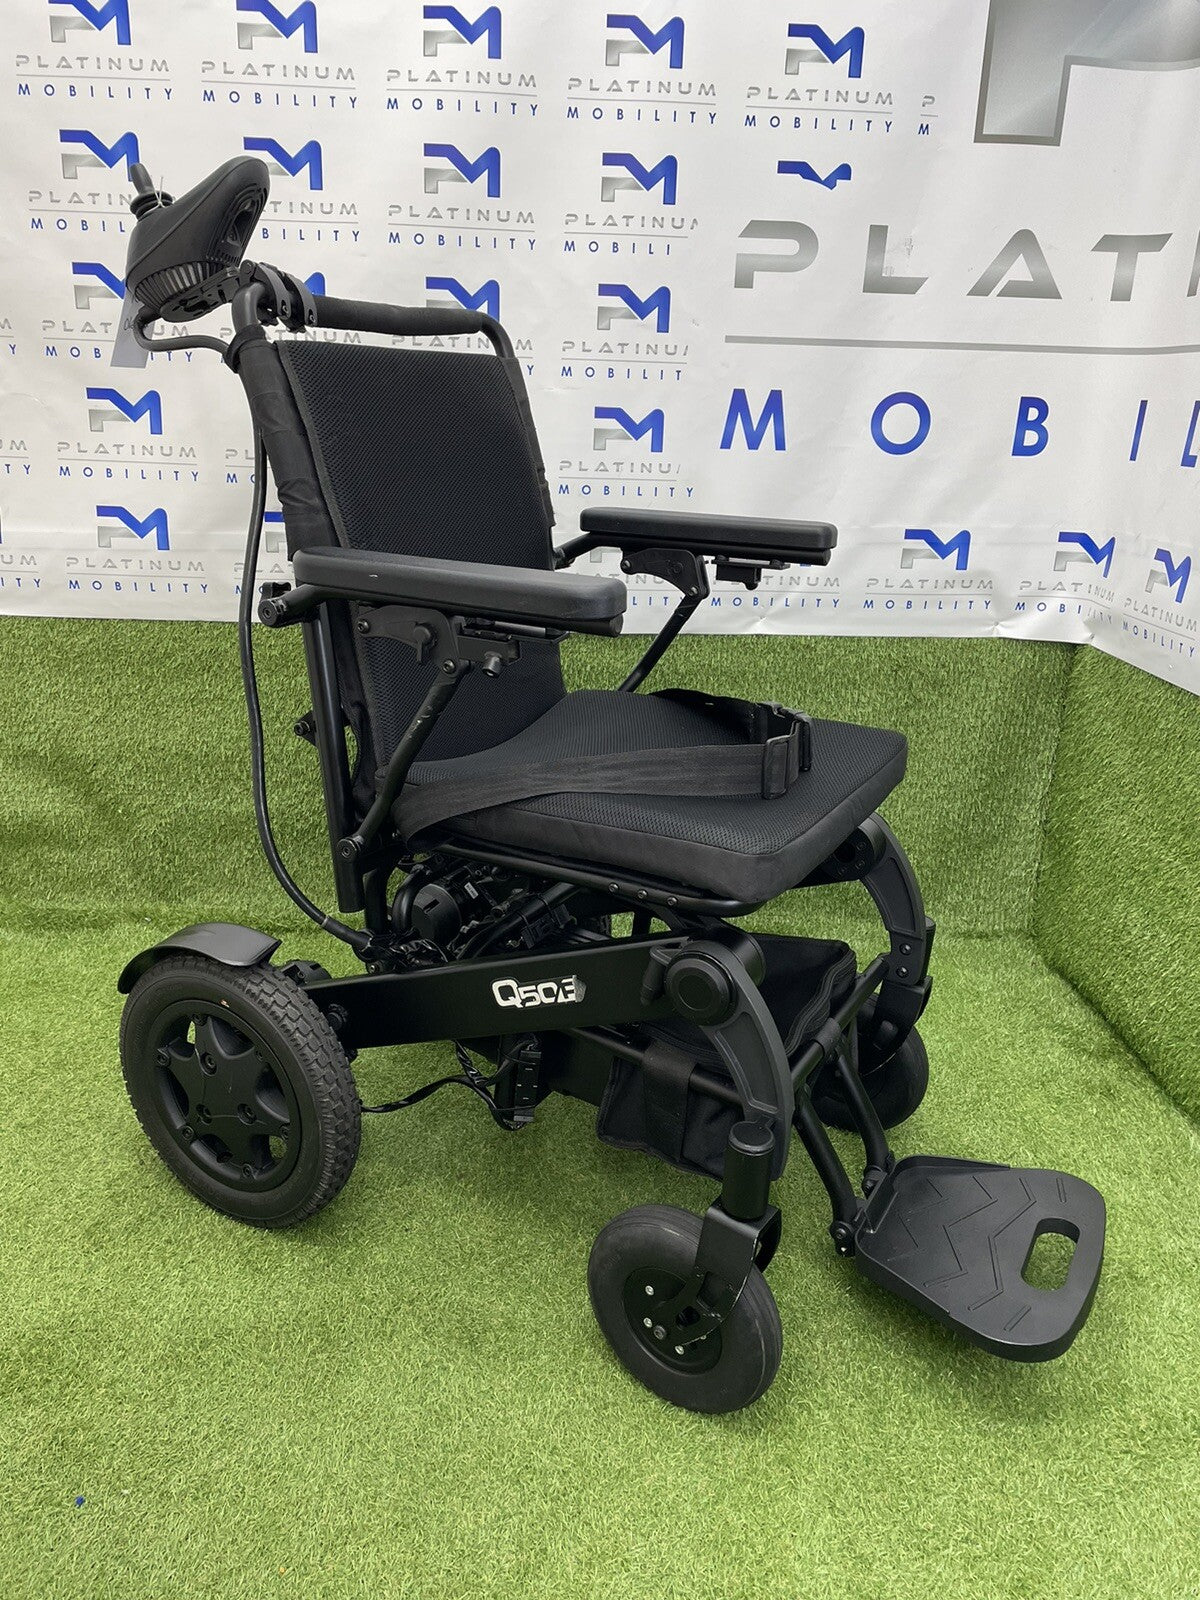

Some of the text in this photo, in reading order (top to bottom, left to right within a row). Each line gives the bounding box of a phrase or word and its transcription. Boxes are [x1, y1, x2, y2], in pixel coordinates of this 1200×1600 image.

[16, 55, 169, 71] PLATINUM
[202, 61, 354, 80] PLATINUM
[387, 70, 536, 88] PLATINUM
[568, 78, 716, 96] PLATINUM
[19, 84, 172, 100] MOBILITY
[203, 90, 357, 108] MOBILITY
[747, 87, 892, 105] PLATINUM
[387, 98, 537, 116] MOBILITY
[567, 107, 716, 124] MOBILITY
[745, 115, 892, 133] MOBILITY
[29, 191, 131, 205] PLATIN
[267, 201, 357, 215] TINUM
[389, 205, 534, 223] PLATINUM
[31, 218, 125, 232] MOBIL
[262, 228, 359, 241] BILITY
[389, 232, 535, 250] MOBILITY
[42, 319, 189, 337] PLATUM
[391, 335, 533, 351] PLATINM
[46, 346, 192, 362] MOBITY
[58, 442, 197, 458] PLATINUM
[60, 466, 198, 481] MOBILITY
[560, 461, 680, 474] PLATINU
[559, 485, 693, 497] MOBILITY
[67, 558, 204, 571] PLATINUM
[69, 580, 207, 593] MOBILITY
[725, 575, 840, 587] TINUM
[866, 577, 993, 590] PLATINUM
[711, 597, 839, 607] MOBILITY
[863, 600, 990, 609] MOBILITY
[1124, 598, 1197, 632] PLATINUM
[1122, 621, 1194, 657] MOBILITY
